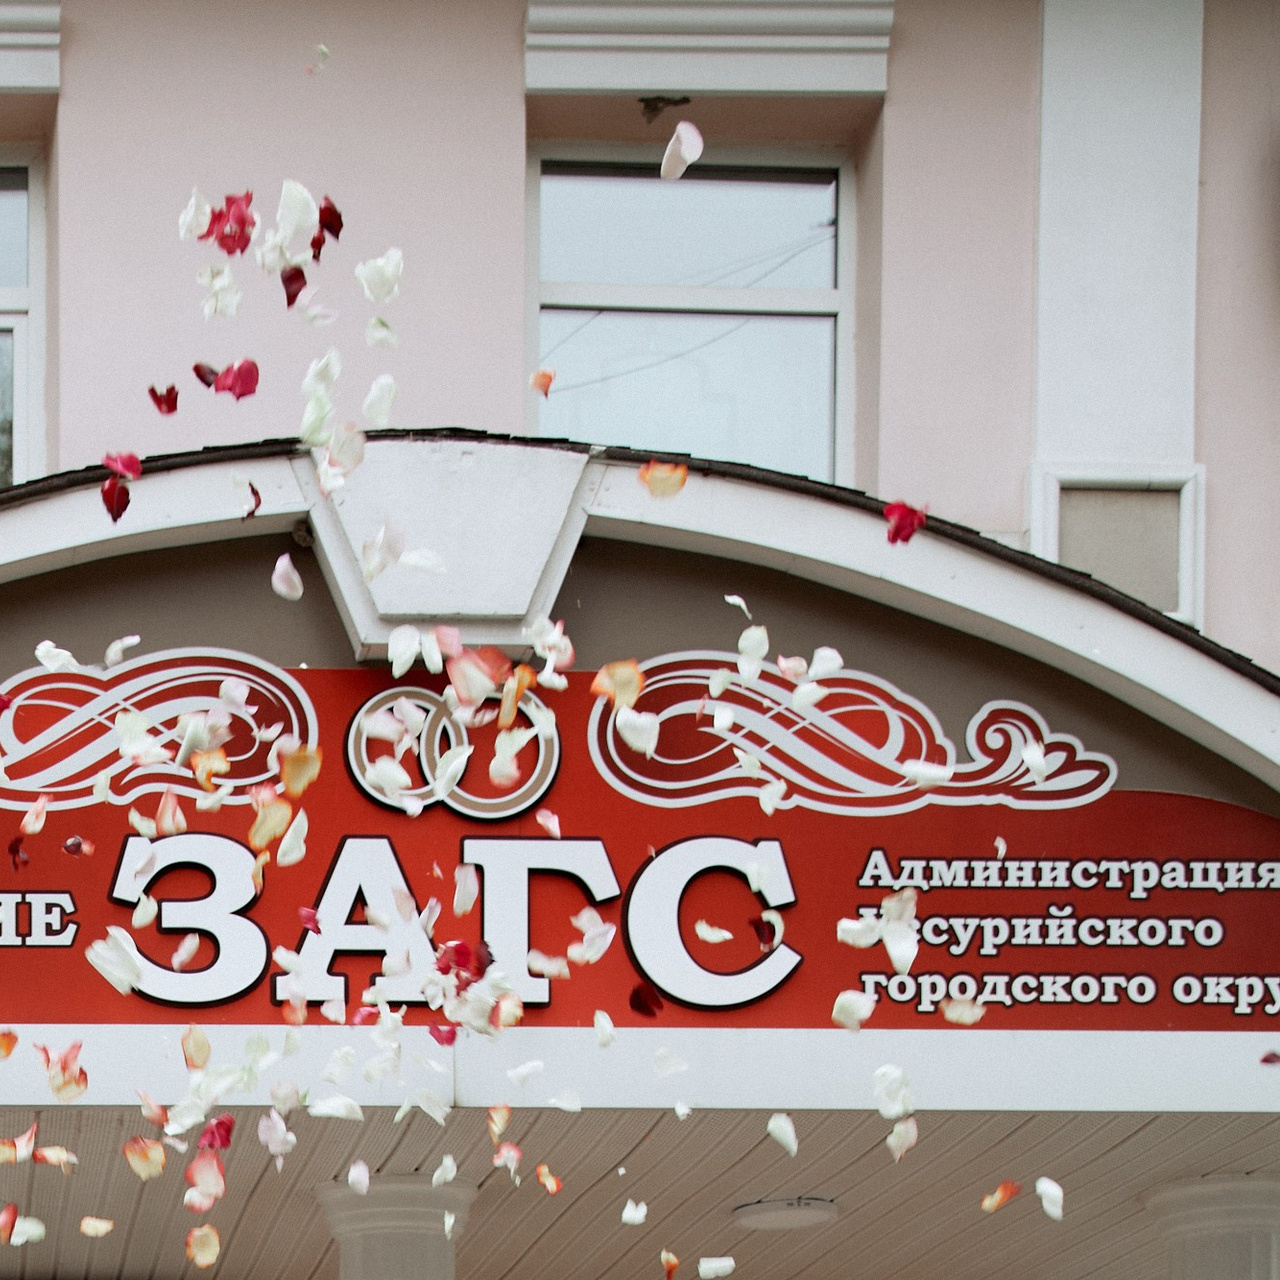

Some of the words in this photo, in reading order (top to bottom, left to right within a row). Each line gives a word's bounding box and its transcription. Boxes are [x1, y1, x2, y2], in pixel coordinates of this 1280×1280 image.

[858, 849, 1280, 899] Администрация
[111, 831, 804, 1007] ЗАГС
[860, 973, 1157, 1012] городского
